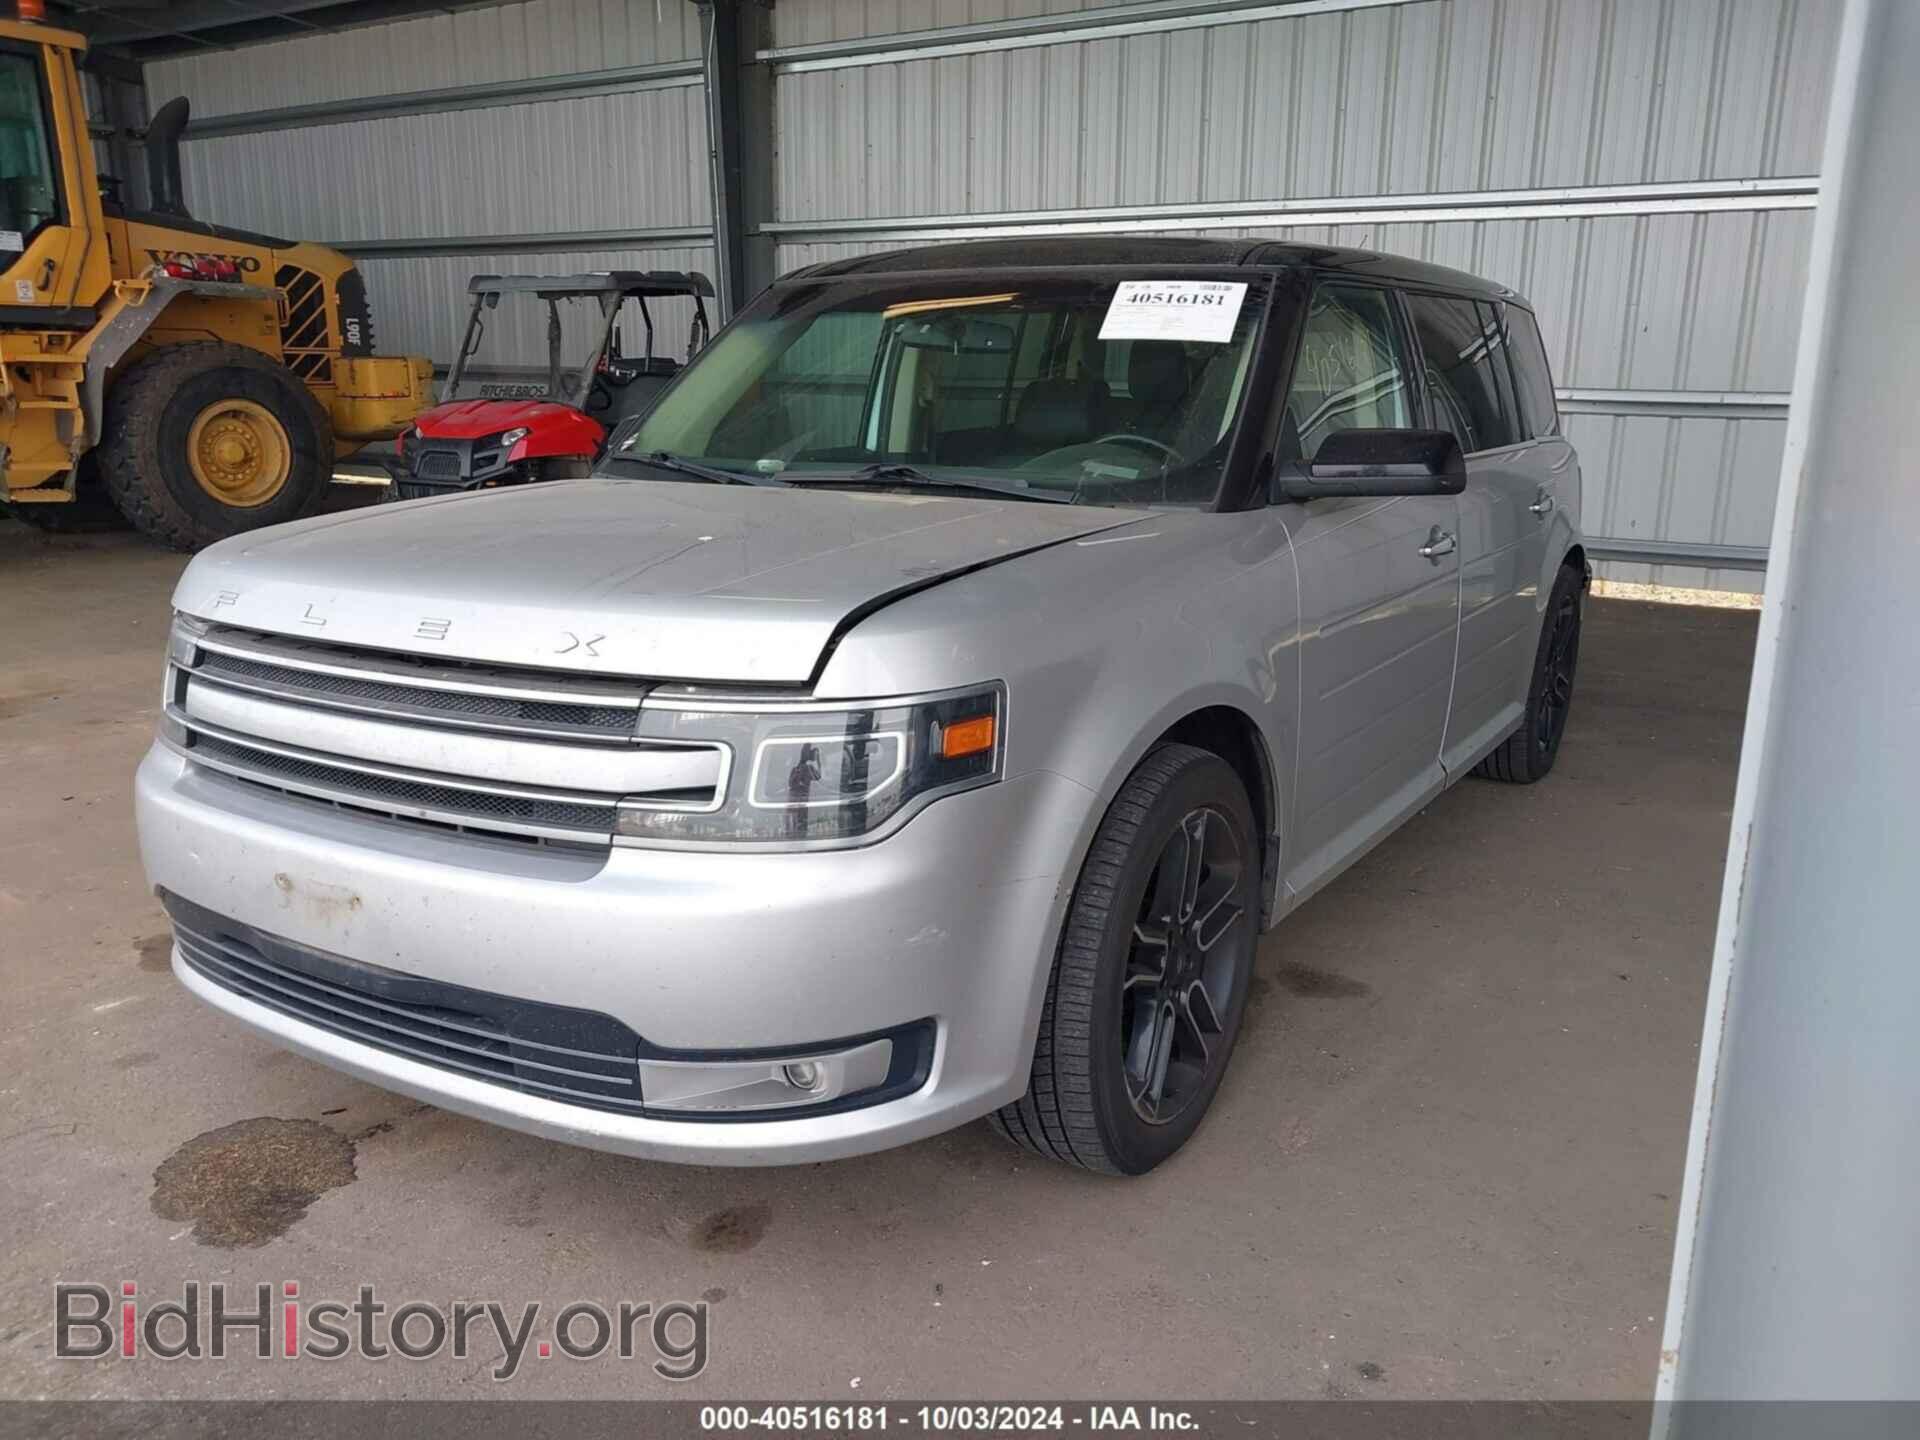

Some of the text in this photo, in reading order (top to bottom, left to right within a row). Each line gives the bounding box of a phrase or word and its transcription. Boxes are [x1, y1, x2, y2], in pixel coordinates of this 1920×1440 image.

[1126, 292, 1225, 306] 40516181
[345, 318, 361, 346] L90F
[215, 590, 607, 656] FLEX
